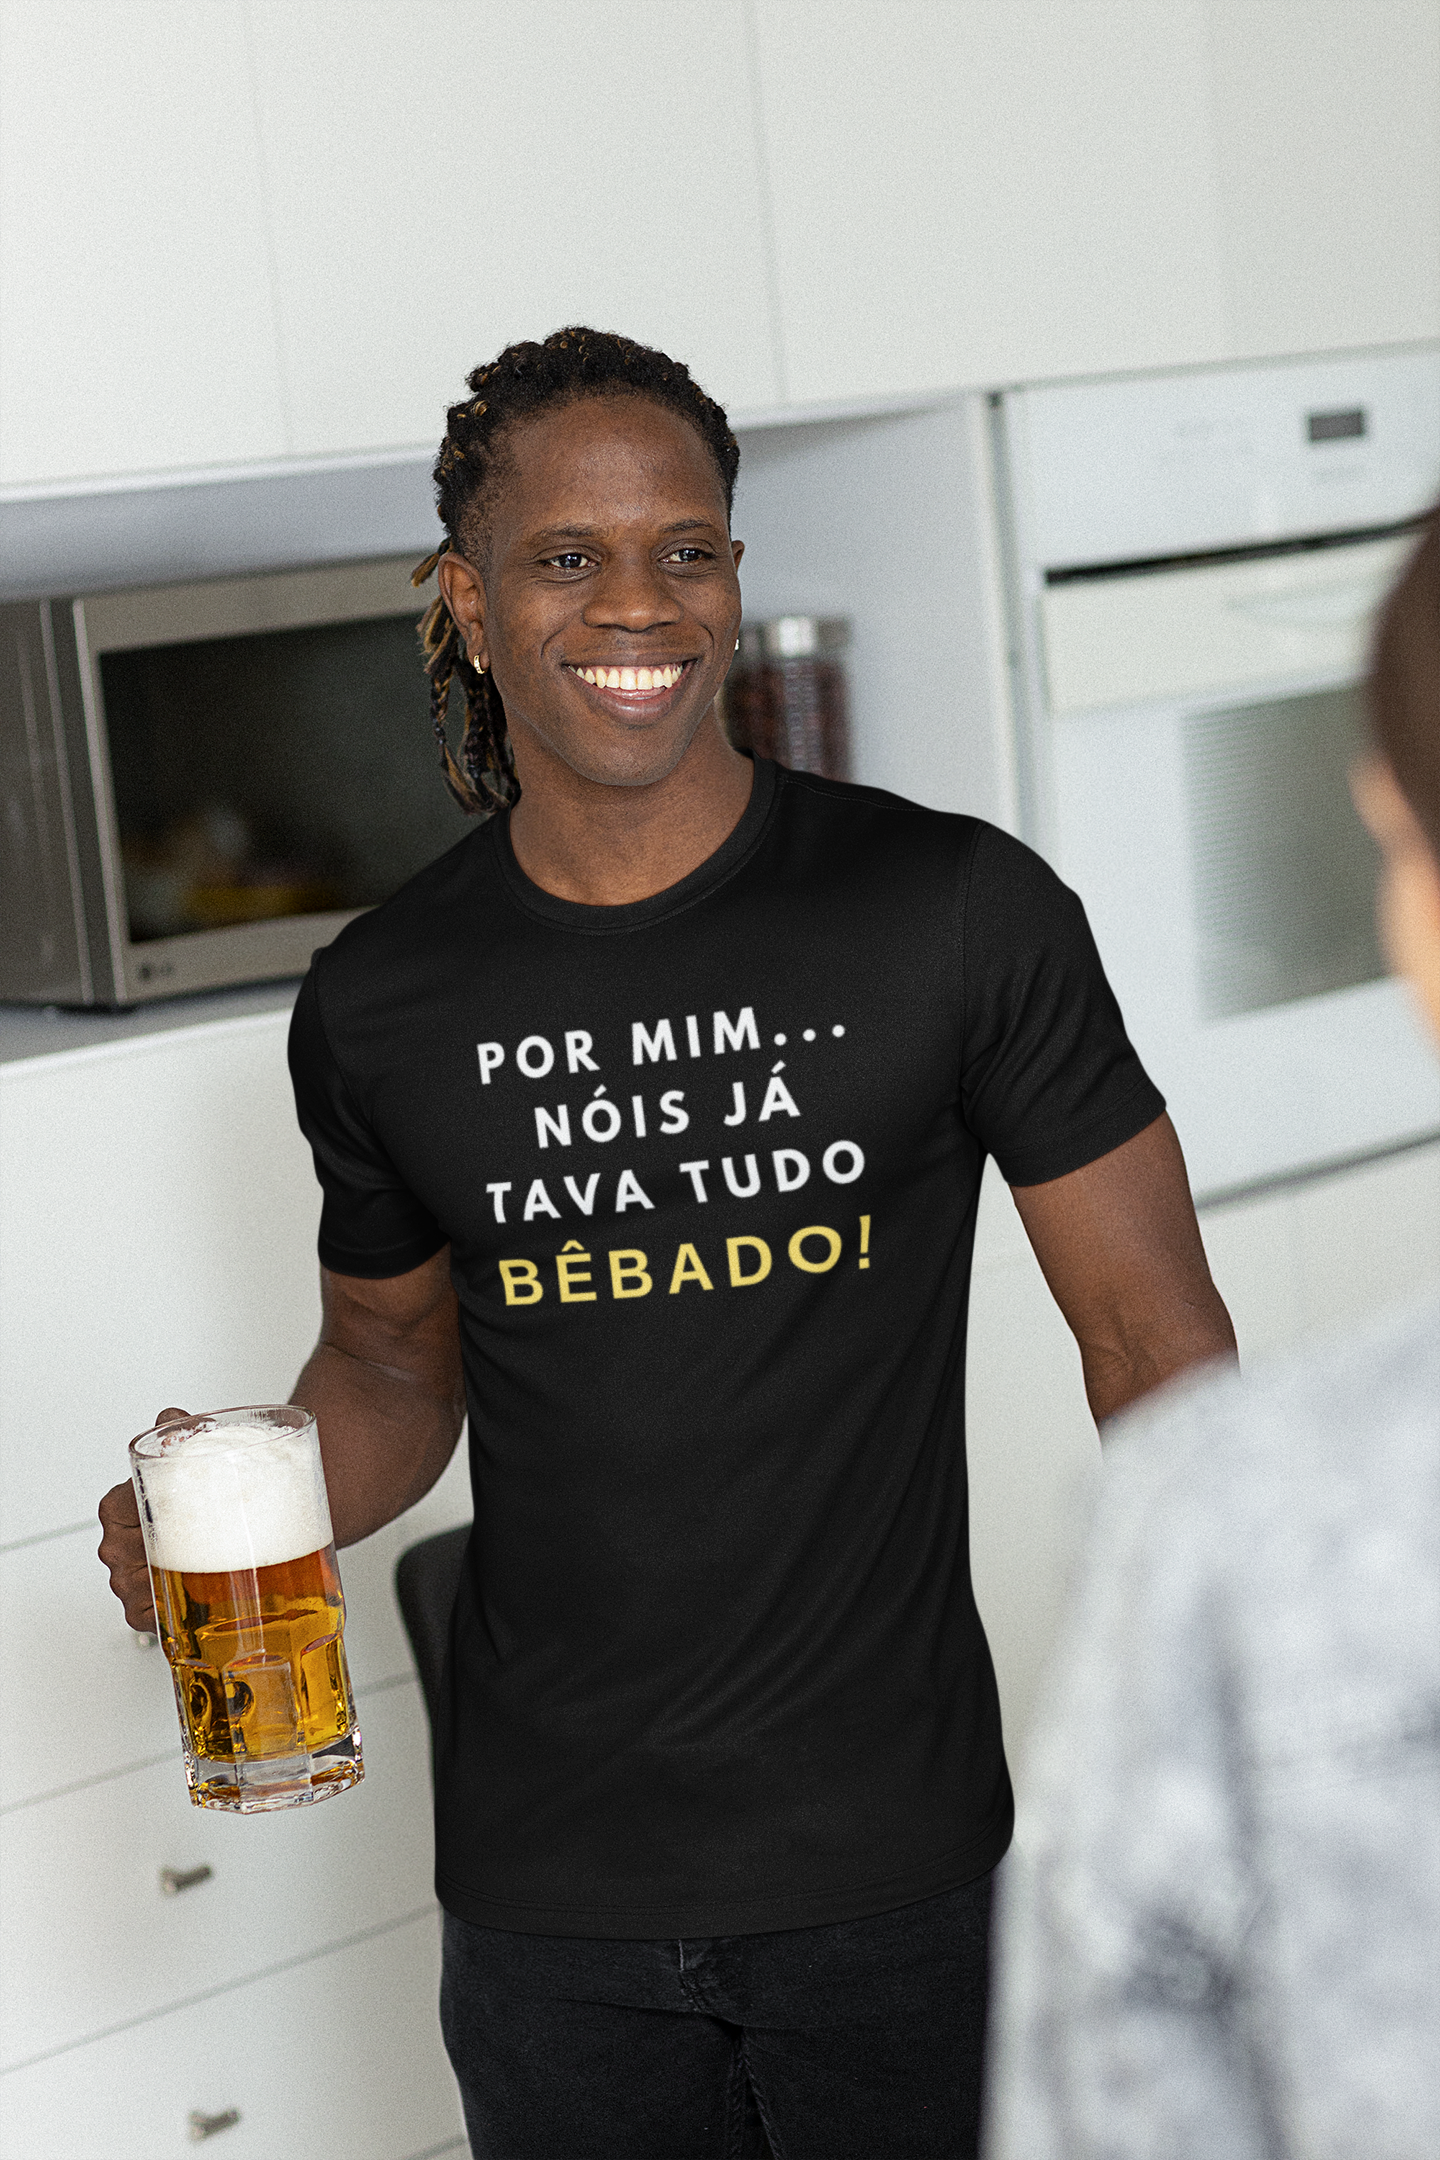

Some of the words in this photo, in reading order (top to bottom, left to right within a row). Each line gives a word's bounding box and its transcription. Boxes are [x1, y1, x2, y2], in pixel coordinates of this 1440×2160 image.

[476, 1029, 601, 1085] POR
[631, 1006, 846, 1066] MIM...
[534, 1084, 690, 1149] NÓIS
[723, 1059, 801, 1127] JÁ
[485, 1169, 655, 1224] TAVA
[678, 1139, 865, 1204] TUDO
[498, 1214, 871, 1306] BÊBADO!
